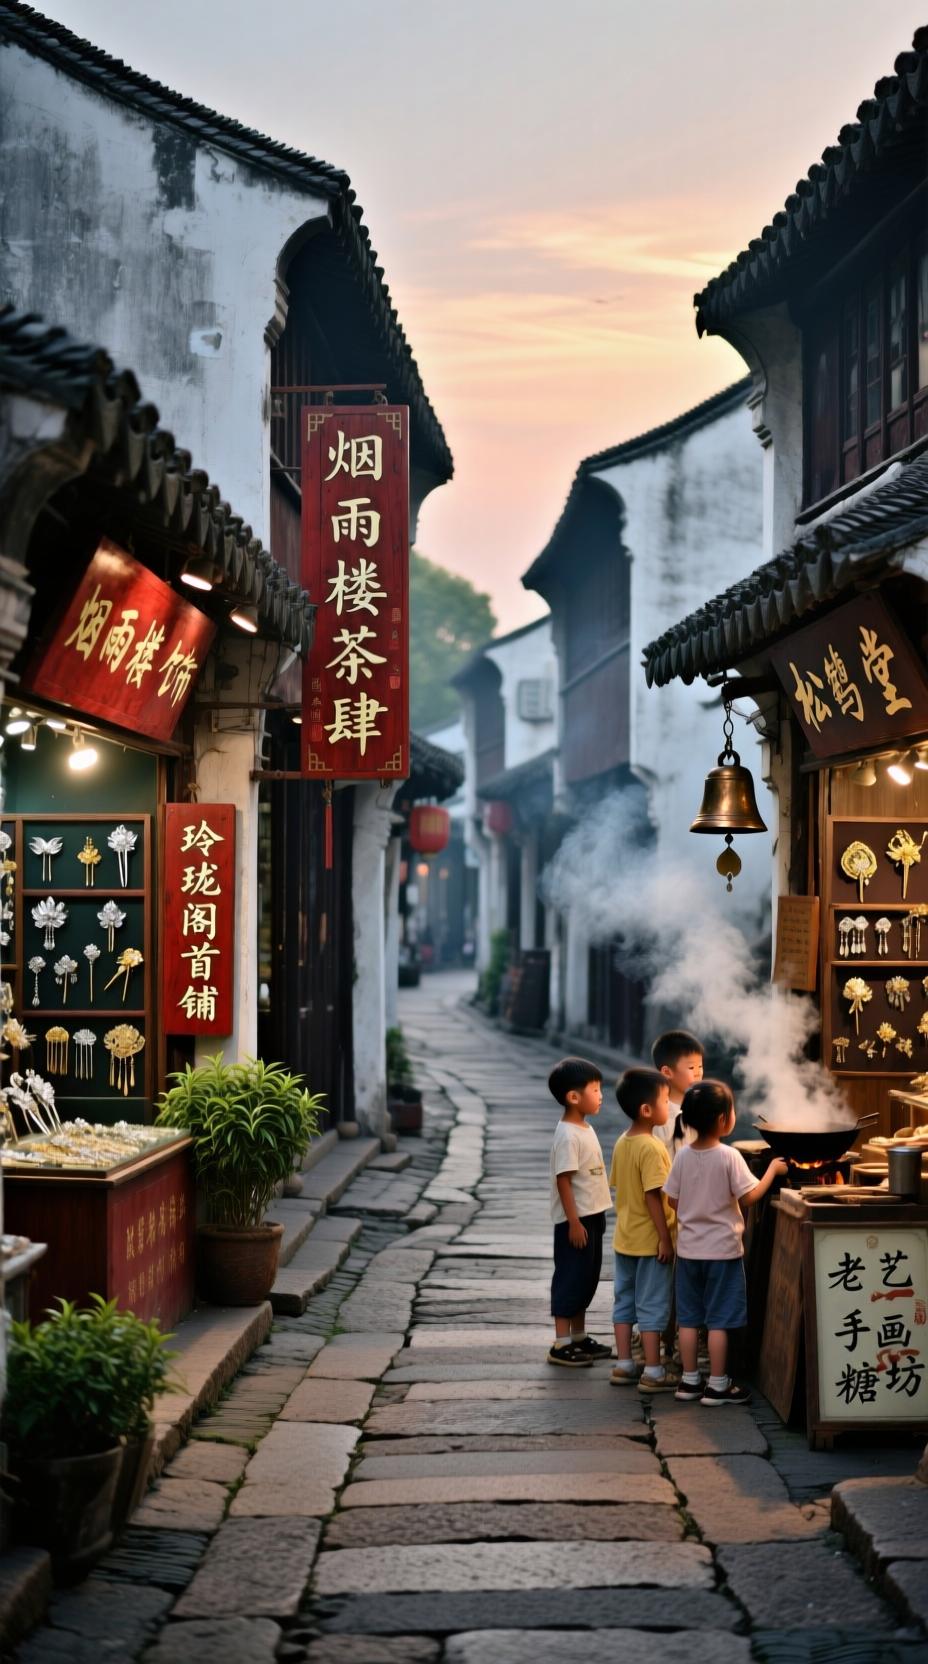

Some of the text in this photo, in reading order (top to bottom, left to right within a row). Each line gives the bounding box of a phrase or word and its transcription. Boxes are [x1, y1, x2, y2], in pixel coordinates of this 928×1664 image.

[64, 583, 198, 708] 烟雨楼饰
[324, 430, 389, 756] 烟雨楼茶肆
[177, 819, 225, 1022] 玲珑阁首铺
